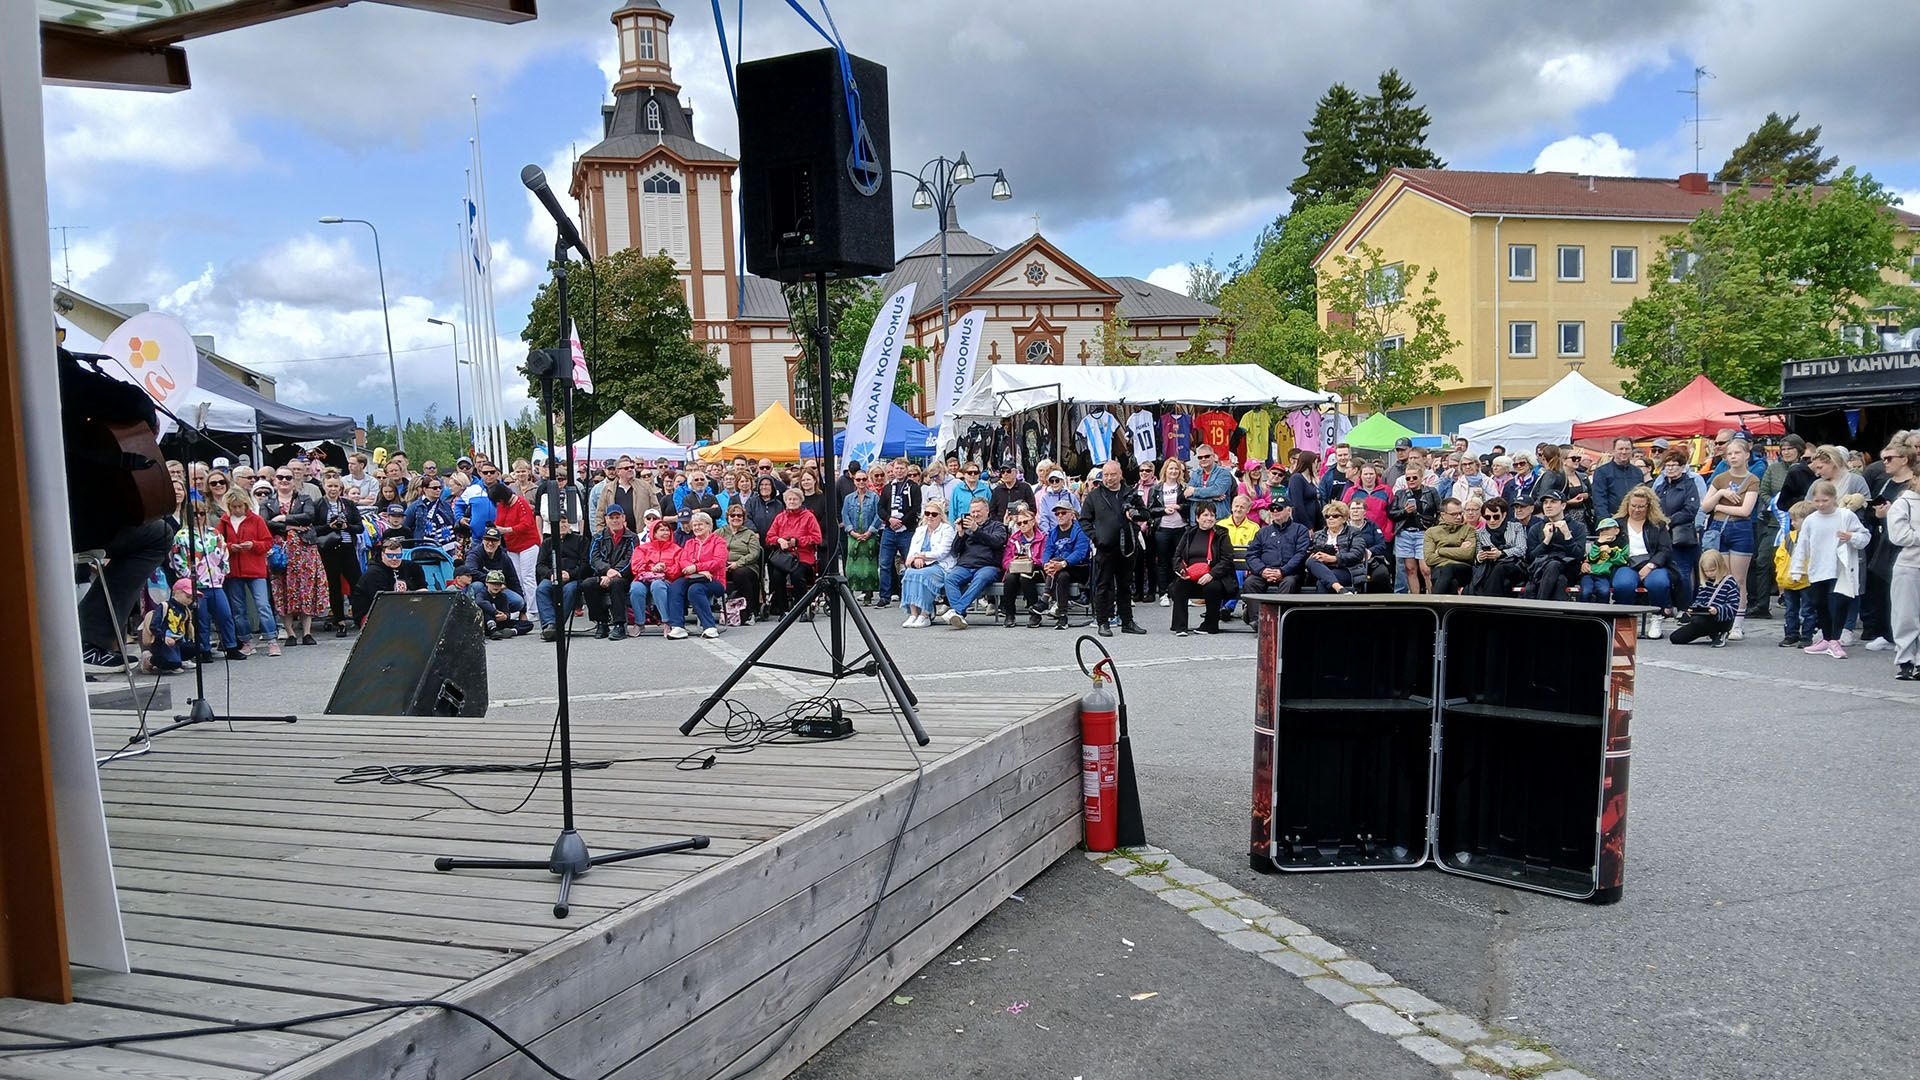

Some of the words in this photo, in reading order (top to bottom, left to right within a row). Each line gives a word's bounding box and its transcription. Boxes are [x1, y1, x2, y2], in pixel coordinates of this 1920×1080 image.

[865, 382, 882, 435] AKAAN
[875, 295, 905, 378] KOKOOMUS
[953, 318, 974, 395] KOKOOMUS
[1792, 360, 1840, 377] LETTU
[1137, 429, 1154, 451] 10
[1210, 426, 1225, 446] 19
